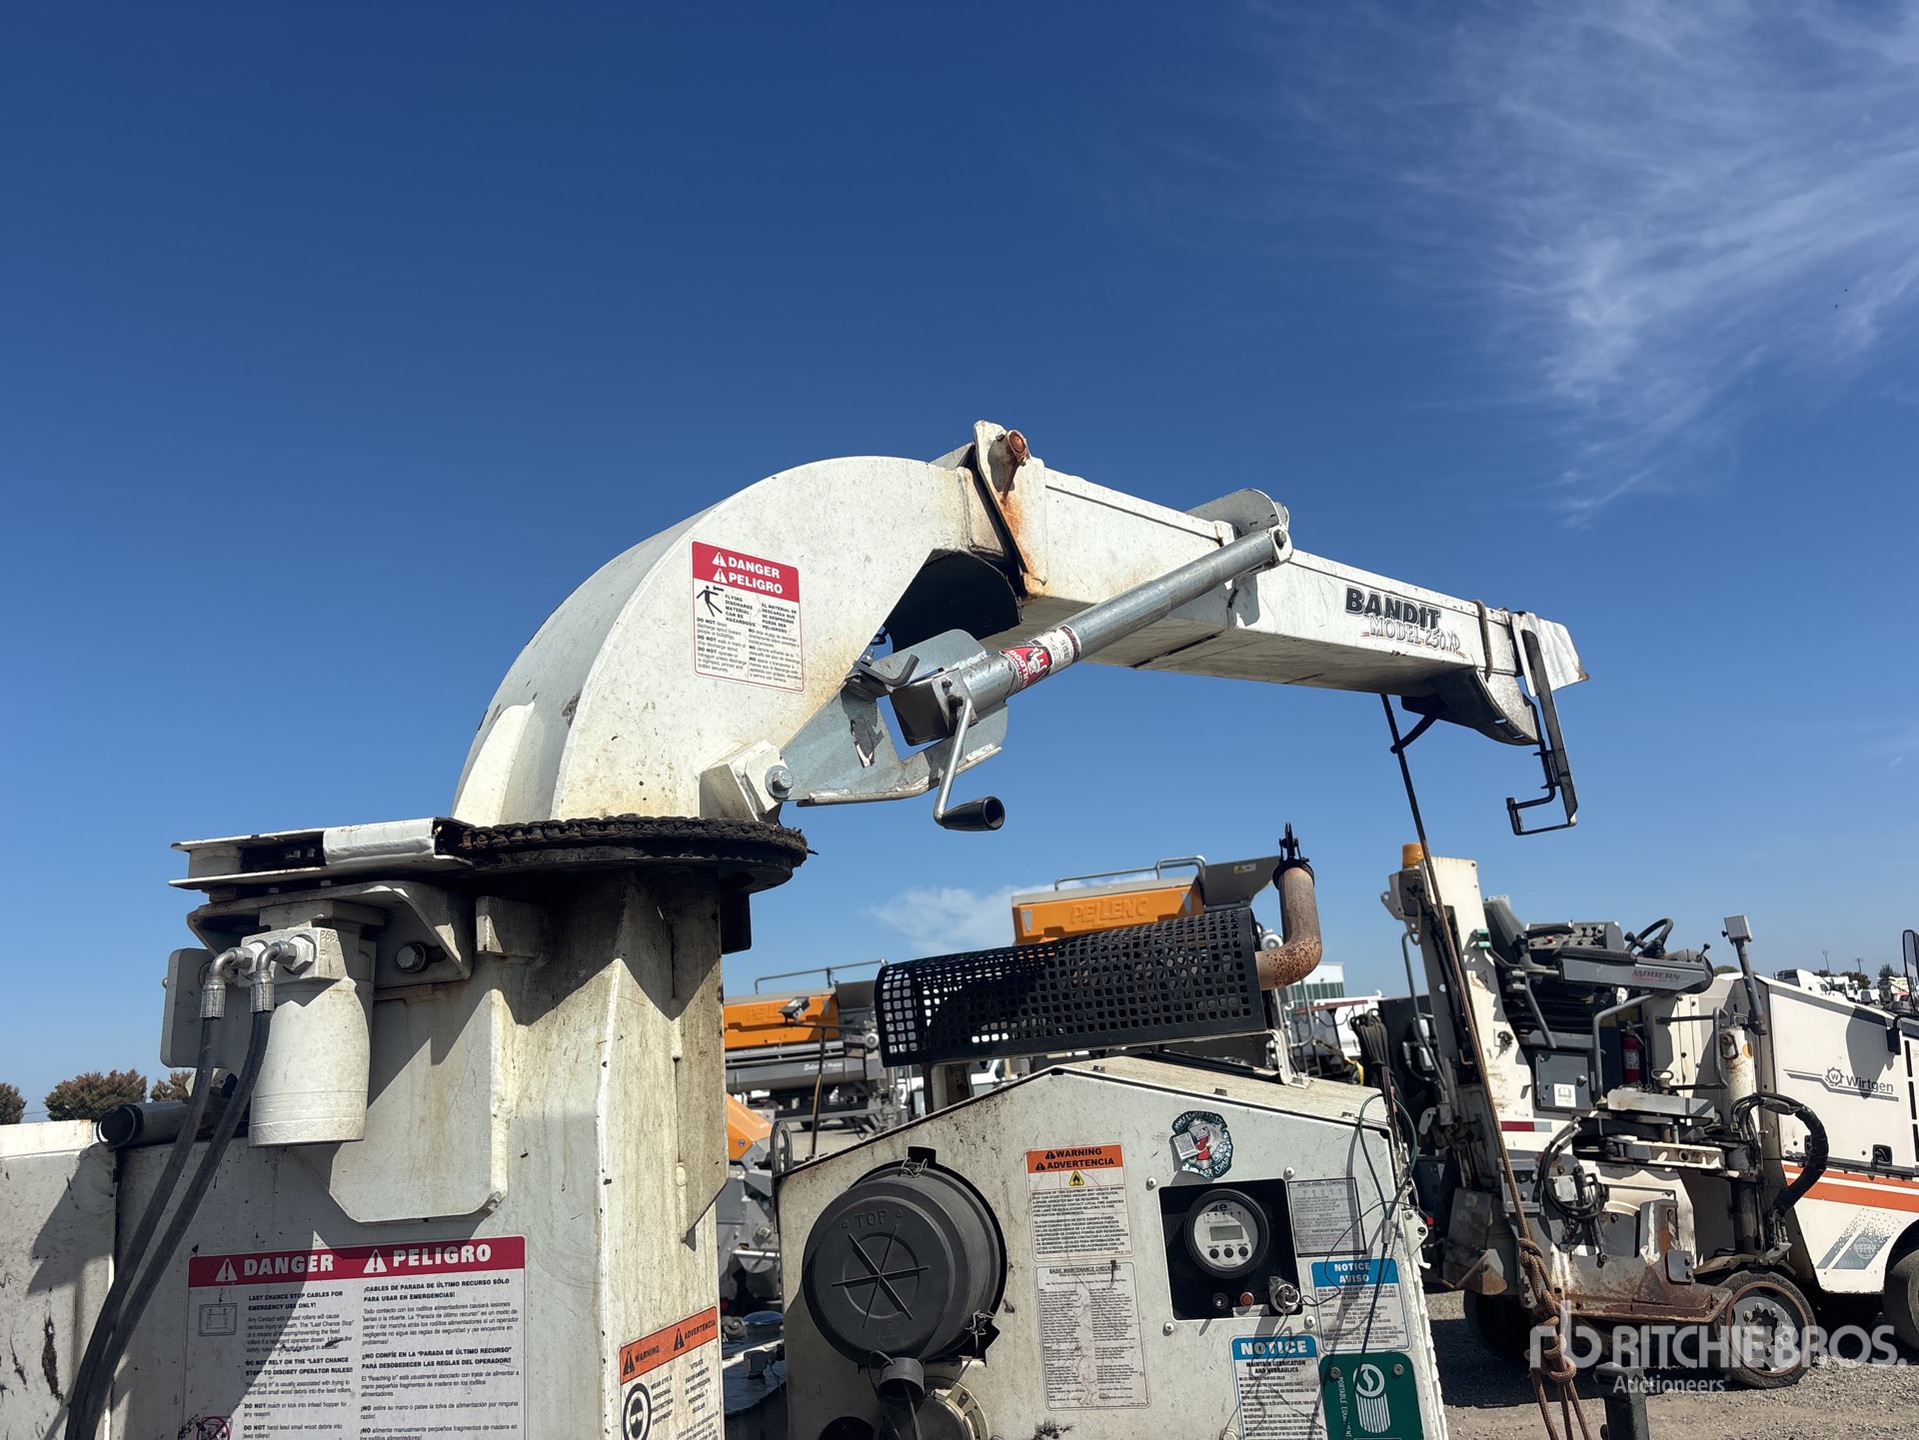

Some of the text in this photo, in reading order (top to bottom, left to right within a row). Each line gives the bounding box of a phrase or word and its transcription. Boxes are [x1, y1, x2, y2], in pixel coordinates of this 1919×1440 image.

[729, 557, 780, 579] DANGER
[729, 572, 783, 594] PELIGRO
[1346, 585, 1440, 630] BANDIT
[1370, 614, 1421, 645] MODEL
[1070, 897, 1148, 927] PELLENC
[1846, 1075, 1894, 1092] Wirtgen
[1047, 1158, 1114, 1169] ADVERTENCIA
[1056, 1148, 1102, 1157] WARNING
[854, 1208, 887, 1227] TOP
[244, 1254, 334, 1276] DANGER
[393, 1244, 492, 1268] PELIGRO
[1334, 1263, 1370, 1271] NOTICE
[1340, 1274, 1369, 1283] AVISO
[409, 1292, 455, 1300] EMERGENCIAS!
[635, 1319, 716, 1363] WARNING ADVERTENCIA
[1241, 1341, 1307, 1355] NOTICE
[1338, 1376, 1348, 1404] PORTABLE
